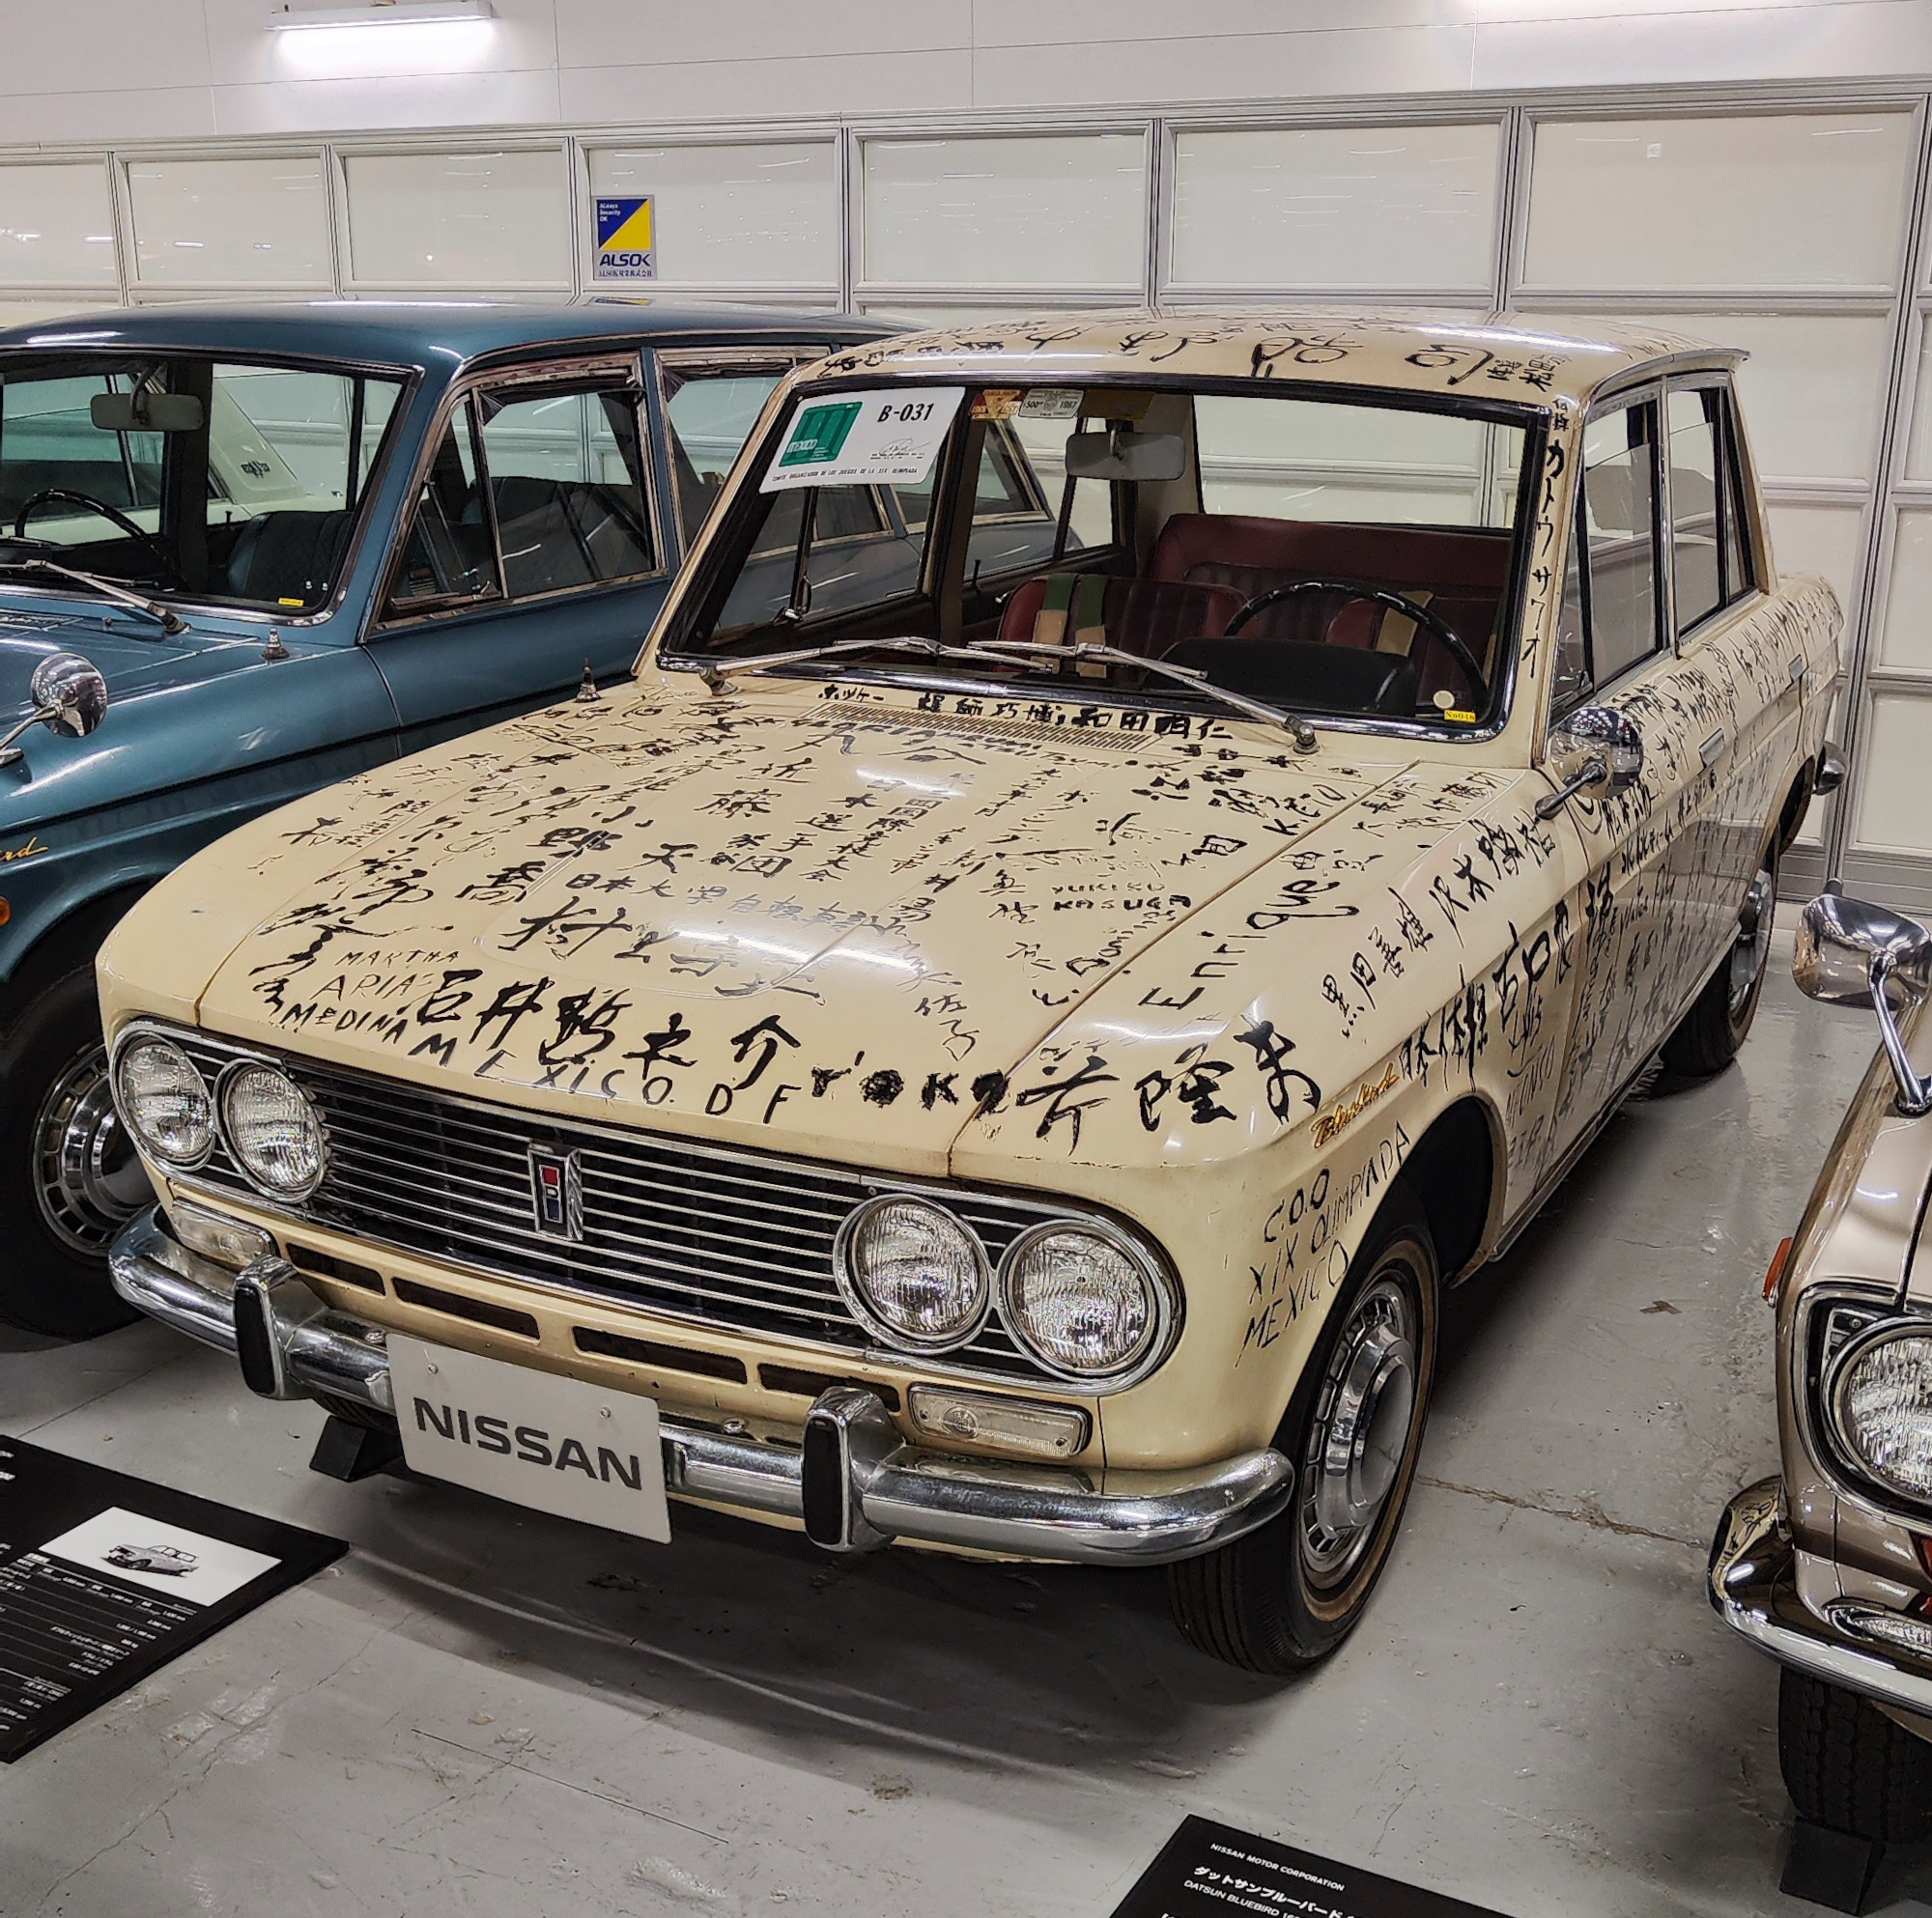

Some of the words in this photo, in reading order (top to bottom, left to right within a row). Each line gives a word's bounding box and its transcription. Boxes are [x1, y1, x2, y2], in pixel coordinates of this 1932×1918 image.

[599, 253, 651, 267] ALSOK
[877, 403, 934, 422] B-031
[334, 949, 463, 968] MARTHA
[1310, 1119, 1411, 1255] OLIMPIADA
[1234, 1238, 1350, 1369] MEXICO
[413, 1396, 642, 1491] NISSAN
[1210, 1843, 1246, 1860] NISSAN
[1246, 1853, 1280, 1871] MOTOR
[1280, 1865, 1346, 1892] CORPORATION
[1183, 1879, 1227, 1900] DATSUN
[1226, 1893, 1281, 1917] BLUEBIRD
